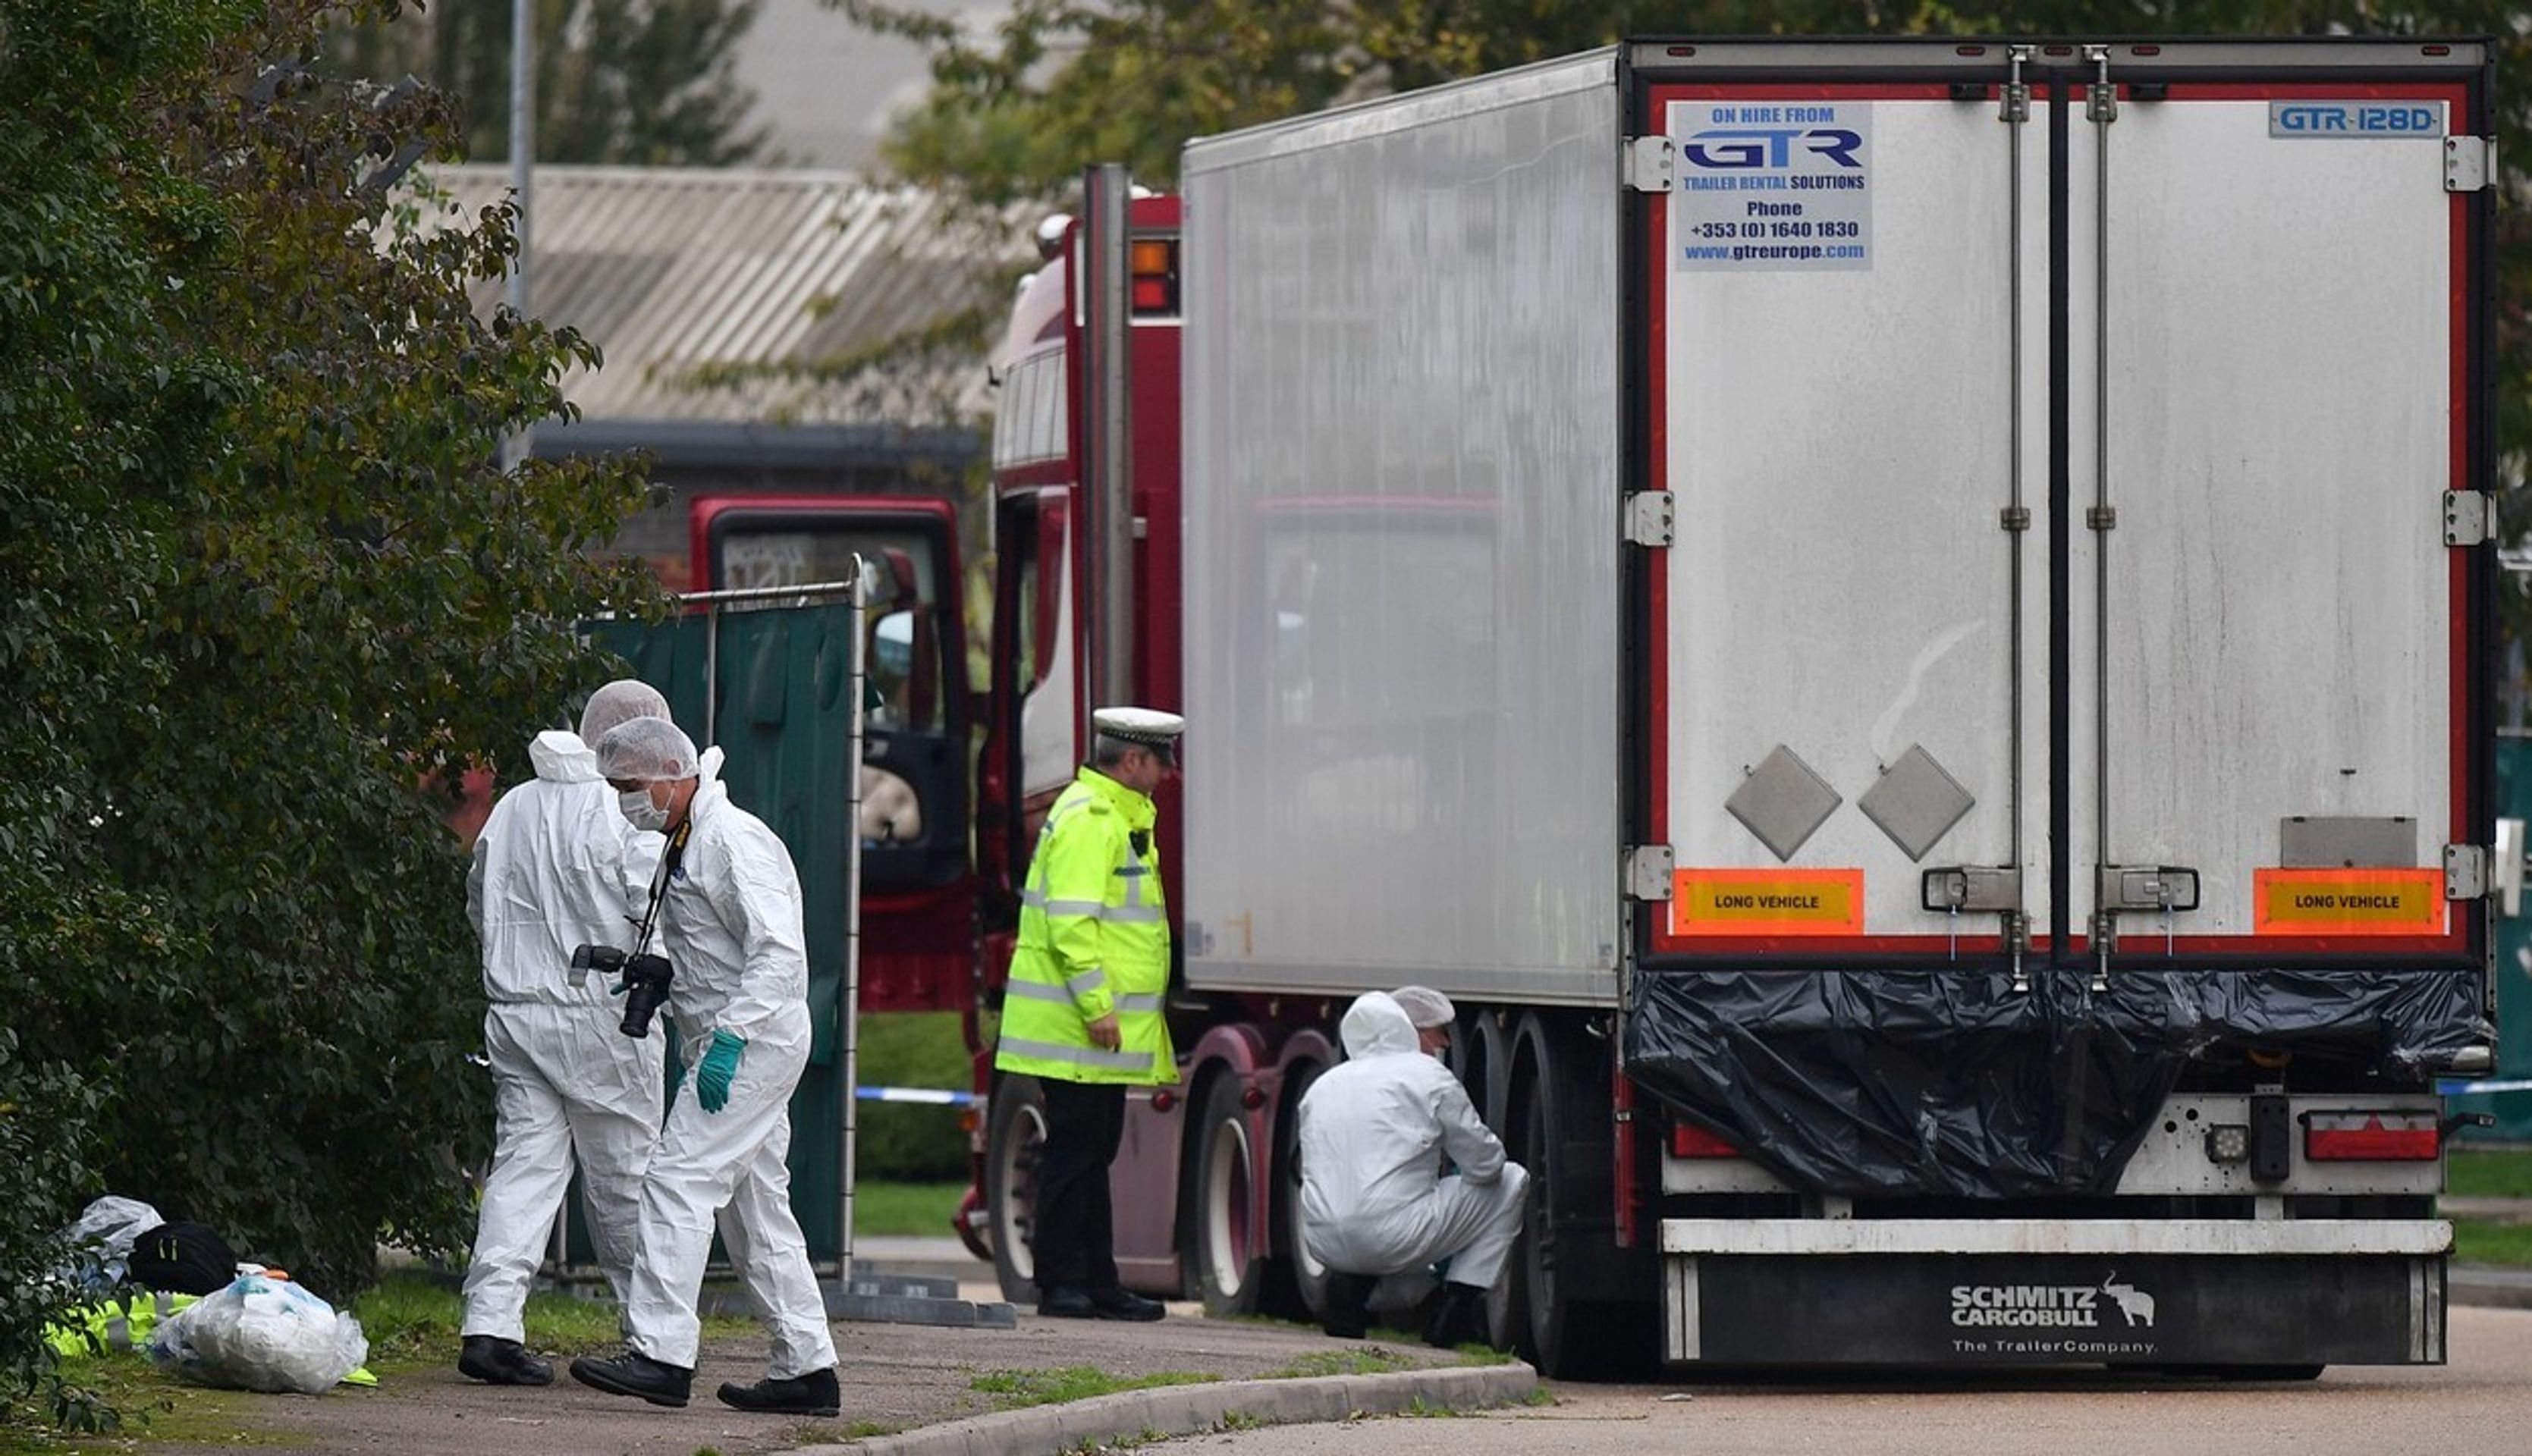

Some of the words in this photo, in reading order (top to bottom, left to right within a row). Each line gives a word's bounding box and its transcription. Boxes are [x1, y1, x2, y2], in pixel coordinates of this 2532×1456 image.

[1712, 108, 1736, 123] ON
[1741, 108, 1781, 123] HIRE
[1786, 108, 1834, 123] FROM
[2280, 107, 2347, 130] GTR
[2358, 108, 2432, 130] 128D
[1684, 130, 1863, 168] GTR
[1684, 176, 1737, 190] TRAILER
[1739, 176, 1788, 190] RENTAL
[1791, 175, 1864, 190] SOLUTIONS
[1747, 201, 1802, 217] Phone
[1692, 223, 1736, 238] +353
[1742, 222, 1766, 238] (0)
[1770, 222, 1812, 237] 1640
[1816, 222, 1858, 237] 1830
[1685, 245, 1864, 261] www.gtreurope.com
[1714, 896, 1754, 909] LONG
[1758, 896, 1820, 908] VEHICLE
[2295, 896, 2335, 908] LONG
[2339, 896, 2399, 908] VEHICLE
[1951, 1285, 2098, 1309] SCHMITZ
[1951, 1309, 2098, 1326] CARGOBULL
[1952, 1340, 1987, 1352] The
